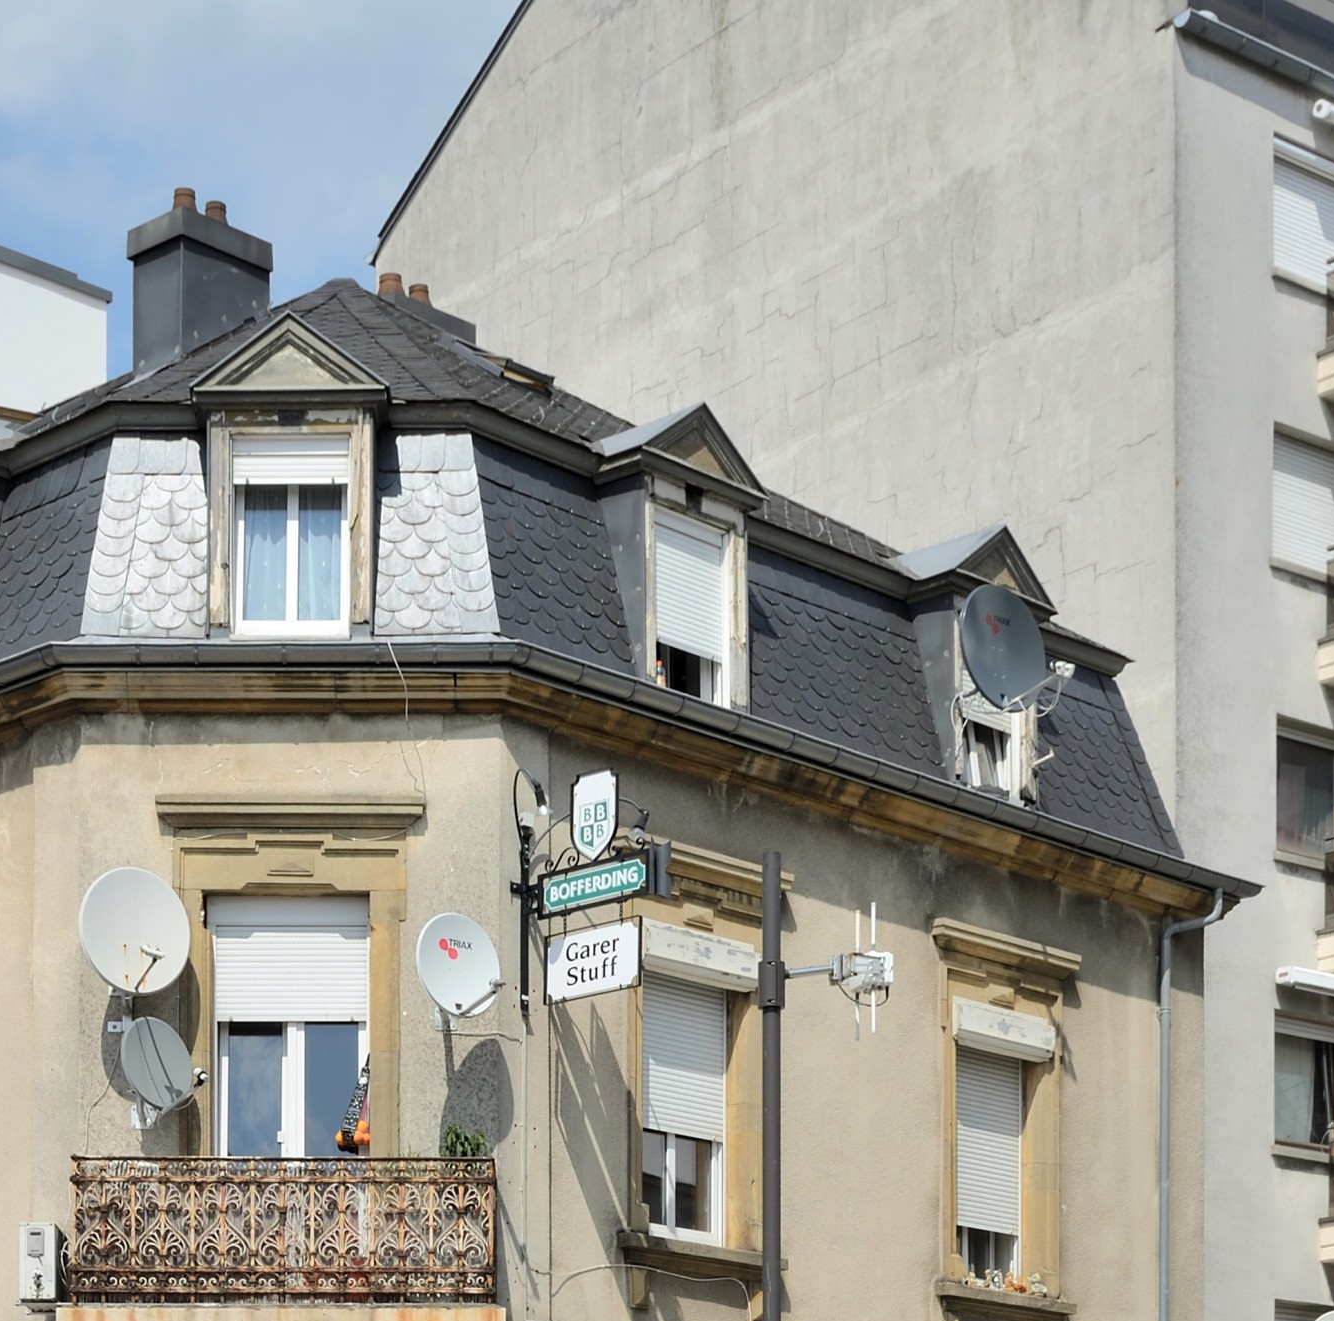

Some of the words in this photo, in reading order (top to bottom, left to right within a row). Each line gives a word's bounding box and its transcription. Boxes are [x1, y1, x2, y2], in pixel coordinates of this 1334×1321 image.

[550, 866, 639, 902] BOFFERDING
[449, 939, 472, 950] TRIAX
[566, 936, 619, 962] Garer
[567, 955, 618, 986] Stuff
